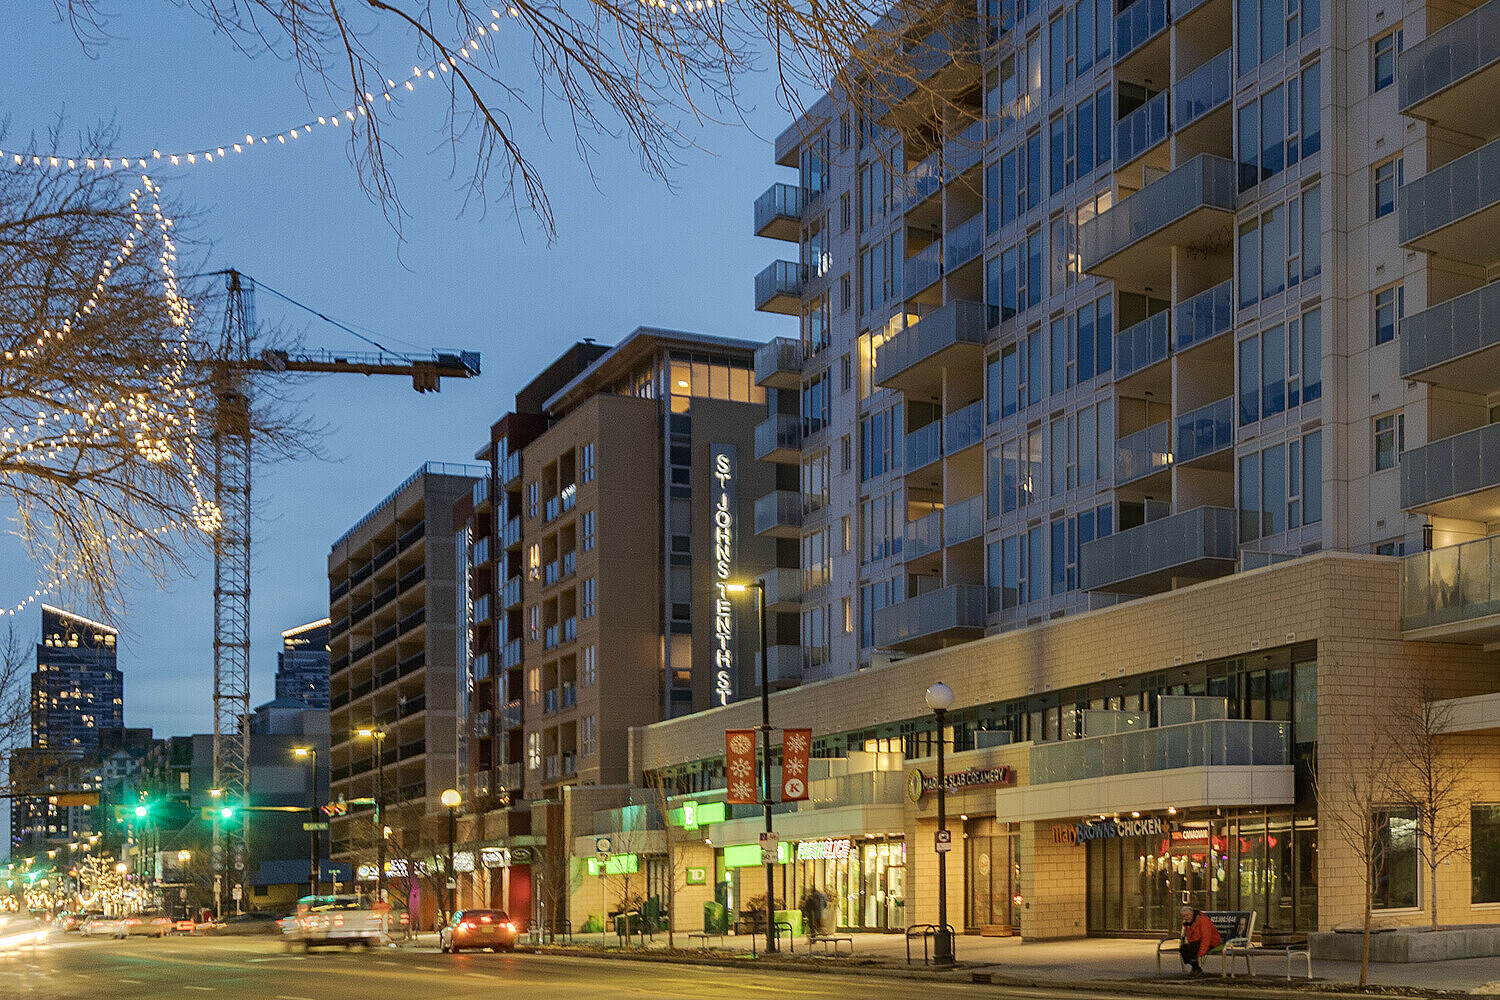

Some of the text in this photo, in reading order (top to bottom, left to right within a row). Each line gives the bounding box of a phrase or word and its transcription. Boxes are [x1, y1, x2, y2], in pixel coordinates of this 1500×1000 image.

[715, 454, 732, 706] ST JOHNS TENTH ST
[948, 773, 966, 788] SLAB
[966, 767, 1004, 785] CREAMERY
[790, 783, 800, 793] K
[1117, 818, 1162, 837] CHICKEN
[1183, 829, 1208, 840] CANADIAN
[687, 868, 705, 881] TD
